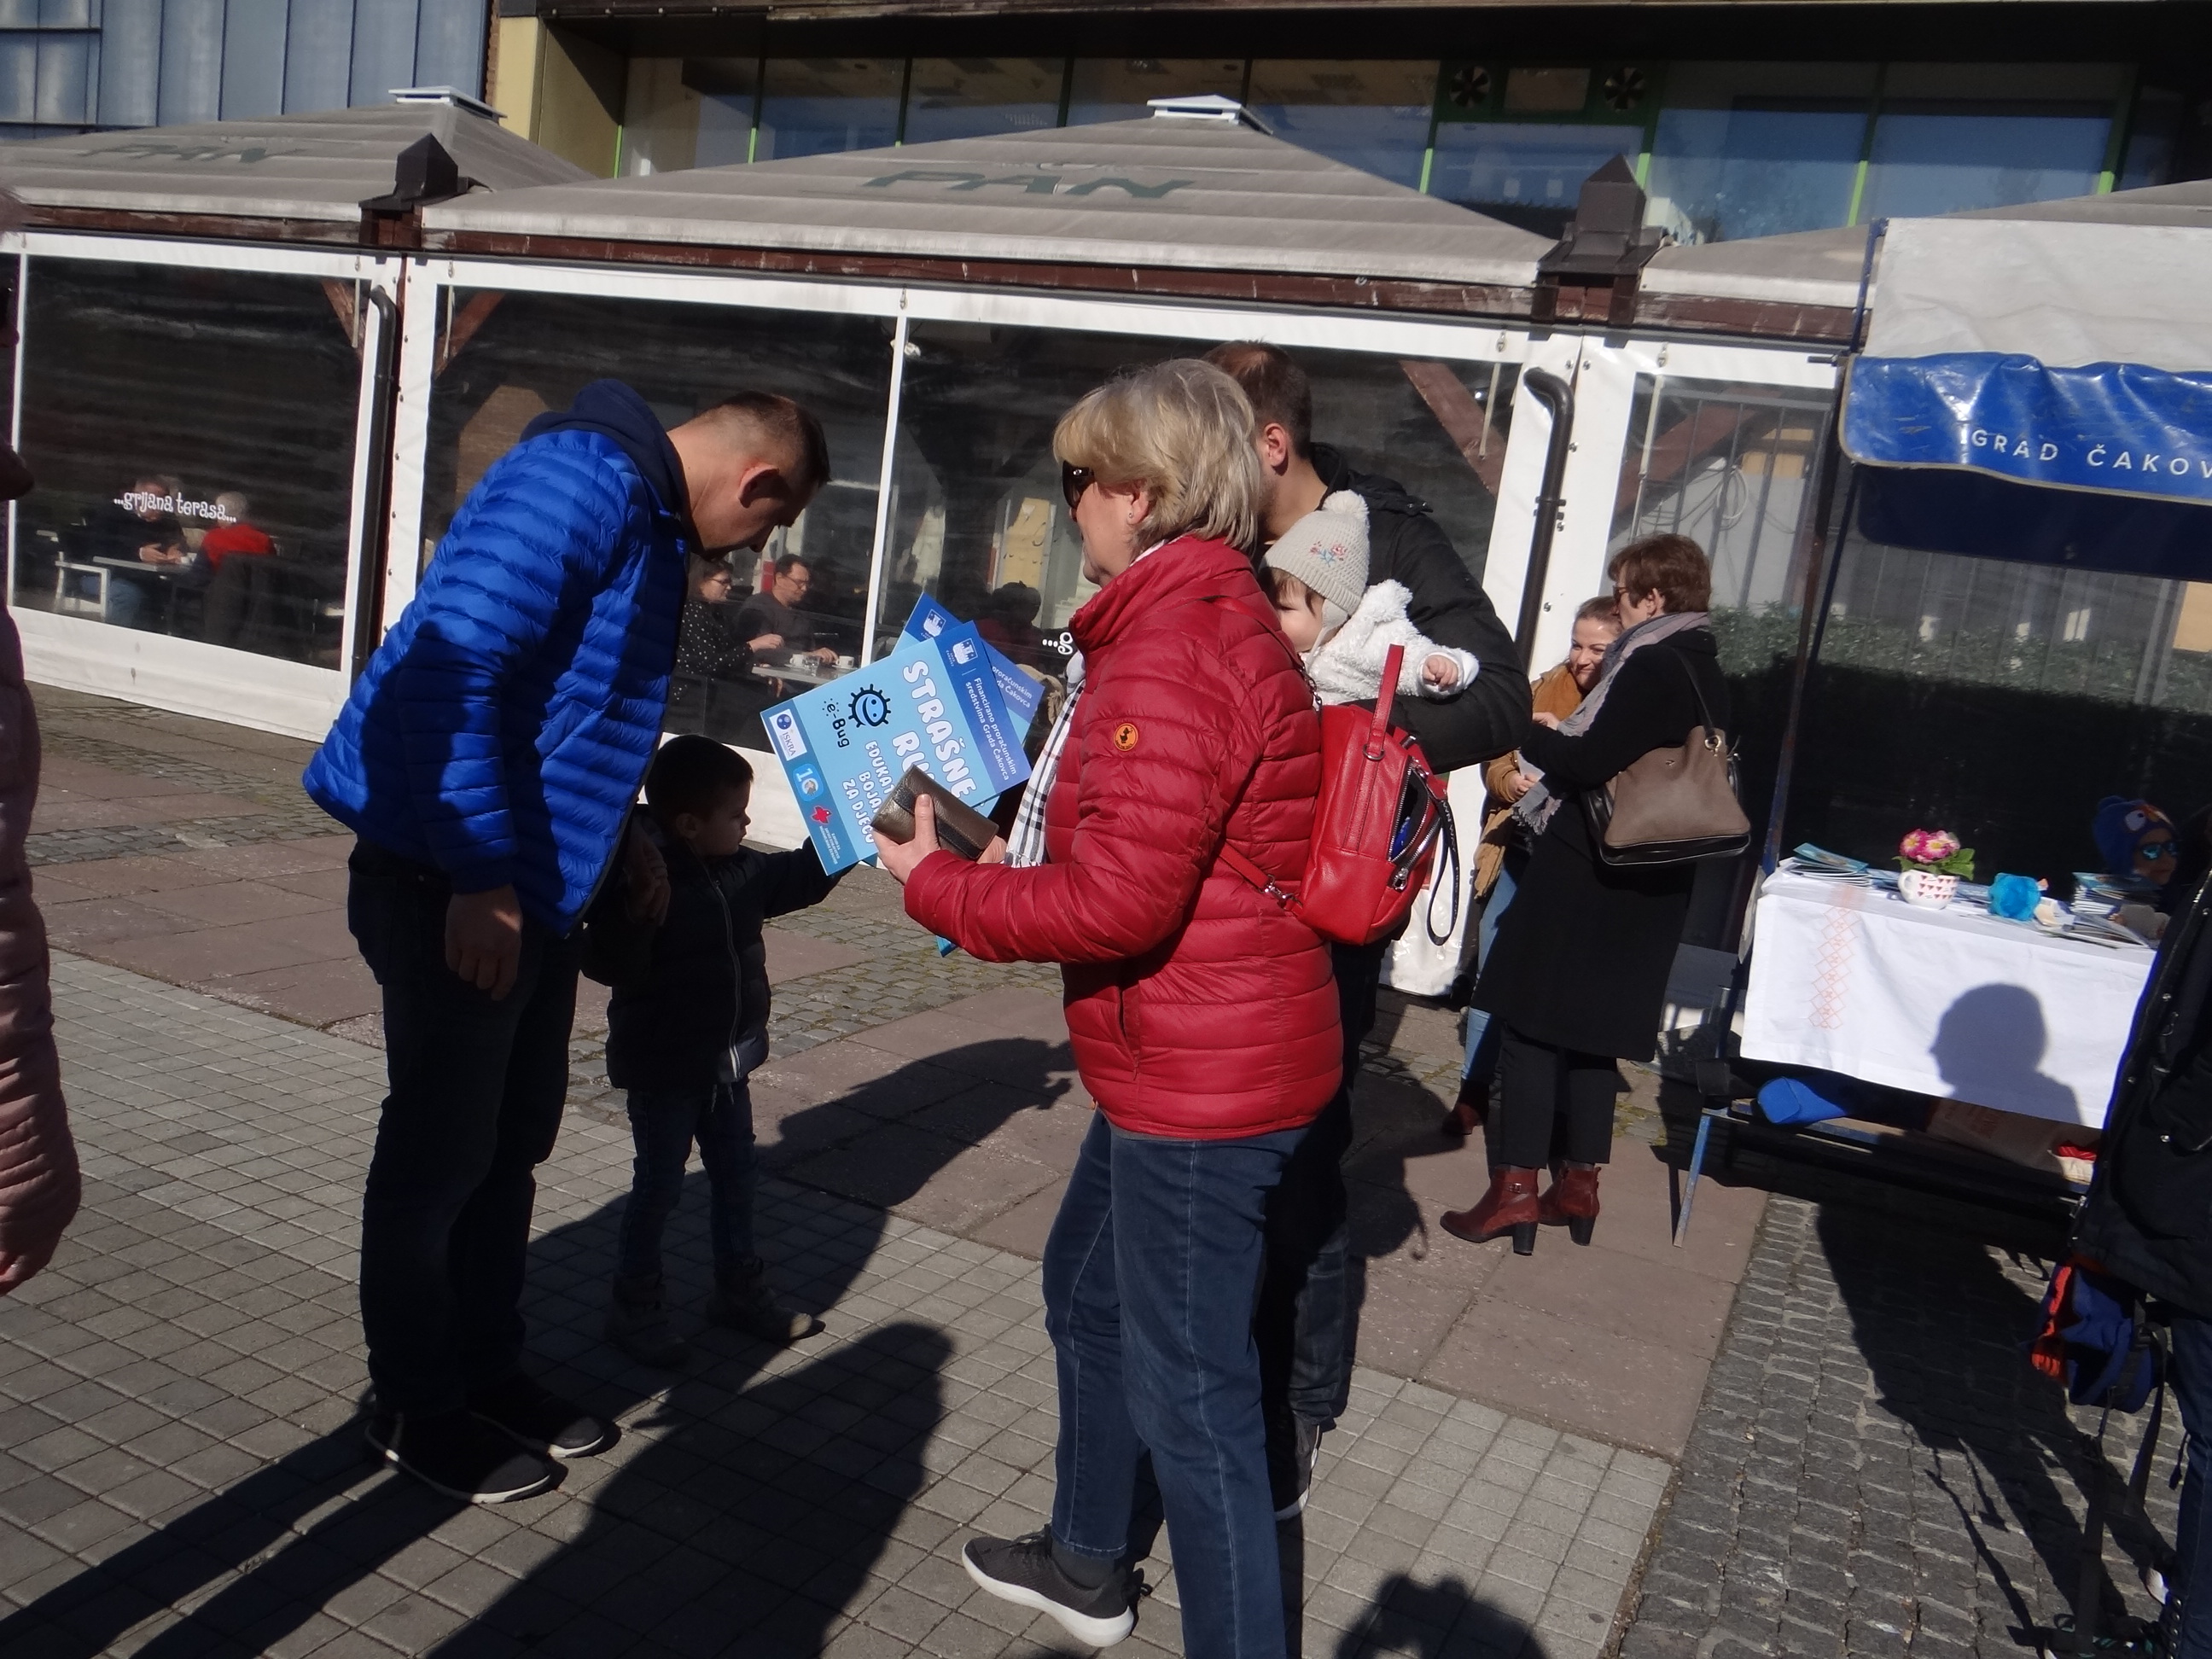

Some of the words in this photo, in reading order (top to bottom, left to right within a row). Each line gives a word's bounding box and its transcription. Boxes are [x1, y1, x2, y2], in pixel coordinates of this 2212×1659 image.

[861, 170, 1194, 199] PAN
[1971, 428, 2059, 461] GRAD
[176, 492, 237, 522] terasa...
[1004, 684, 1031, 708] Čakovca
[782, 731, 796, 756] ISKRA
[826, 703, 850, 748] e-Bug
[903, 661, 977, 798] STRAŠNE
[965, 681, 986, 724] sredstvima
[982, 724, 996, 748] Grada
[992, 748, 1010, 781] Čakovca
[974, 677, 995, 723] Financirano
[990, 724, 1017, 775] proračunskim
[864, 740, 895, 794] EDUKAT
[892, 731, 935, 780] RU
[842, 778, 859, 800] ZA
[852, 800, 875, 843] DJECU
[859, 771, 882, 812] BOJA
